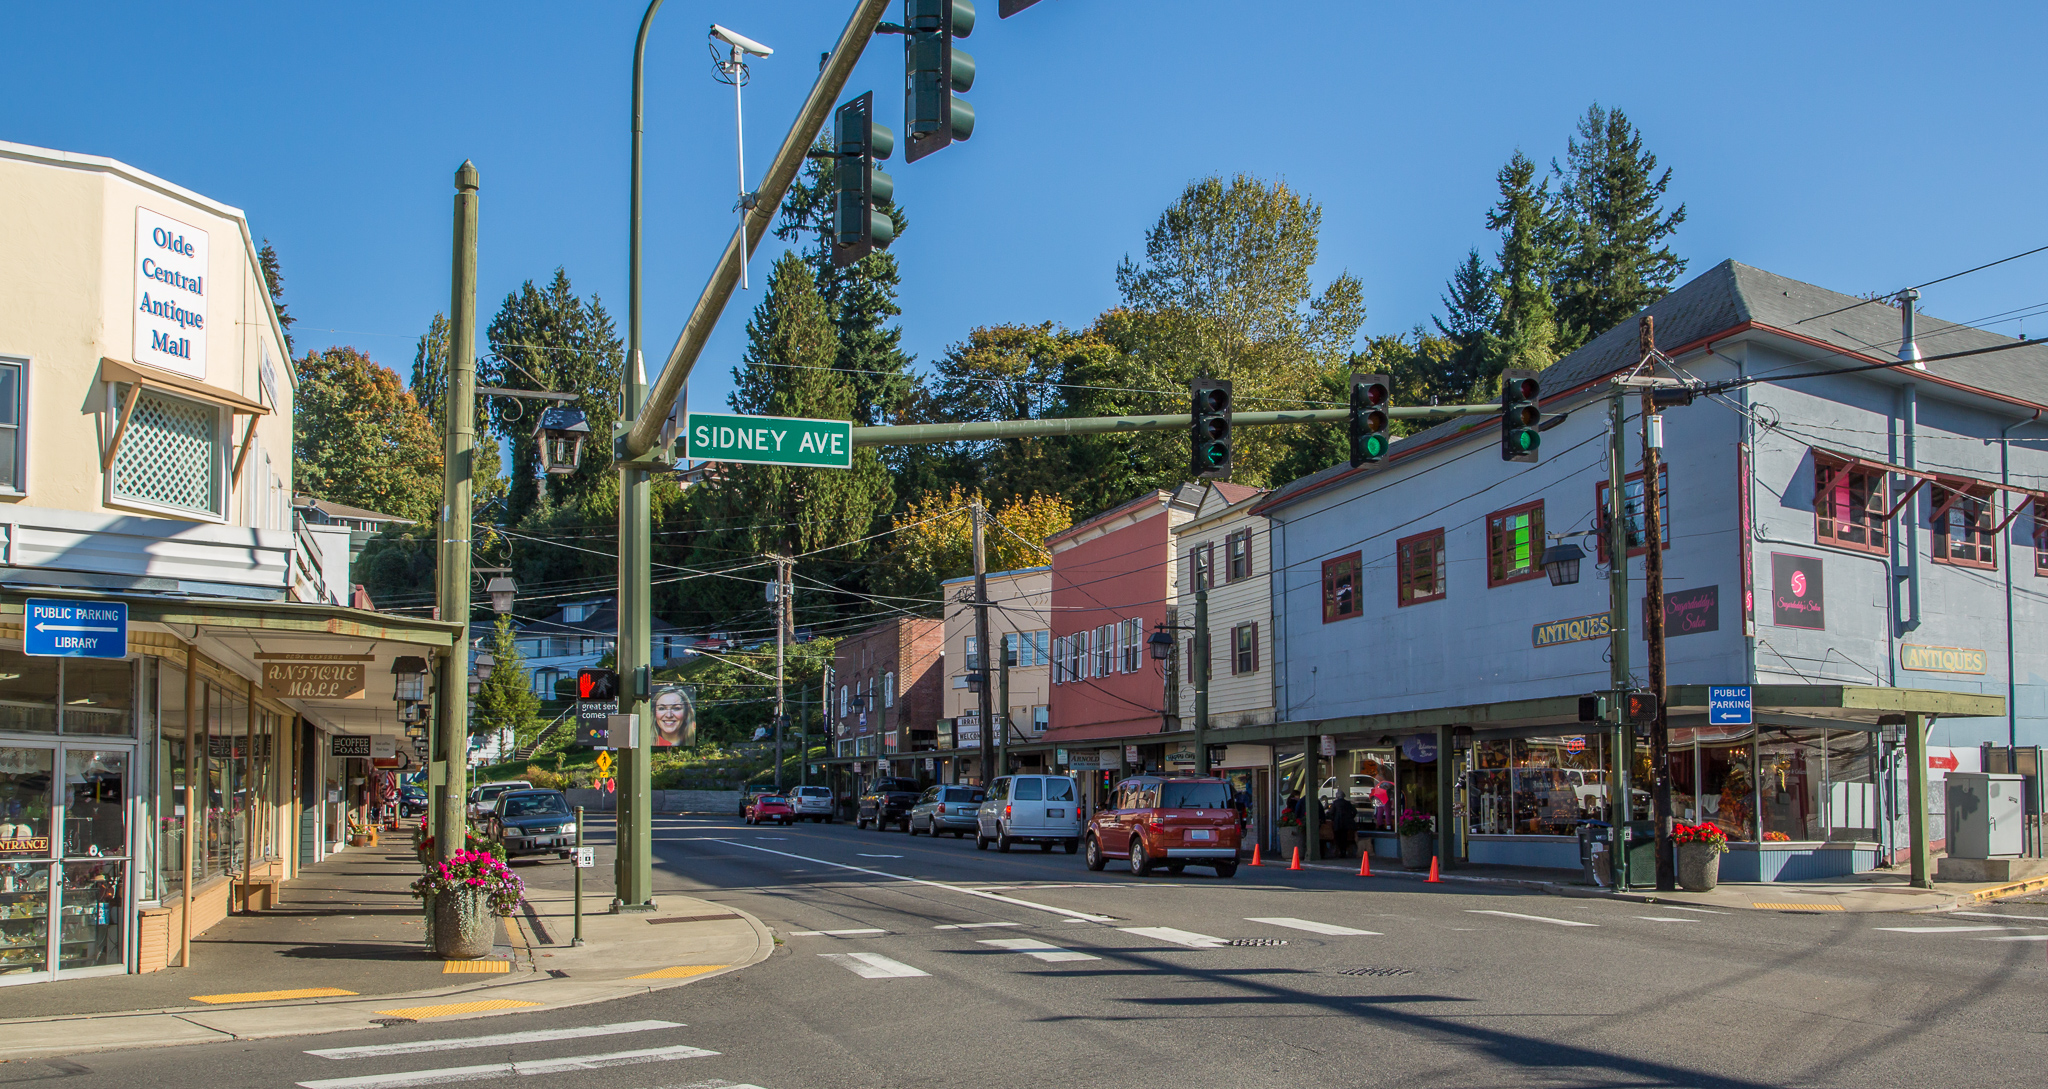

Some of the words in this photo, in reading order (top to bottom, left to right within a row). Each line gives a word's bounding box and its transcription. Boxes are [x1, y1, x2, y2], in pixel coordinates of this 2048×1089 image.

[153, 227, 195, 258] Olde
[142, 257, 204, 297] Central
[139, 291, 204, 330] Antique
[151, 329, 191, 361] Mall
[695, 425, 788, 452] SIDNEY
[798, 431, 844, 455] AVE
[1667, 592, 1715, 617] Sugardaddy's
[34, 606, 72, 620] PUBLIC
[76, 608, 119, 621] PARKING
[1536, 616, 1610, 645] ANTIQUES
[1682, 613, 1706, 632] Salon
[55, 636, 98, 649] LIBRARY
[1908, 648, 1983, 673] ANTIQUES
[268, 664, 358, 681] ANTIQUE
[287, 681, 340, 697] MALL
[1713, 688, 1747, 697] PUBLIC
[581, 703, 602, 712] great
[602, 703, 619, 711] serv
[1710, 700, 1751, 709] PARKING
[340, 737, 369, 747] COFFEE
[1567, 740, 1585, 751] OPEN
[1167, 753, 1184, 761] HAPPY
[0, 839, 48, 850] NTRANCE
